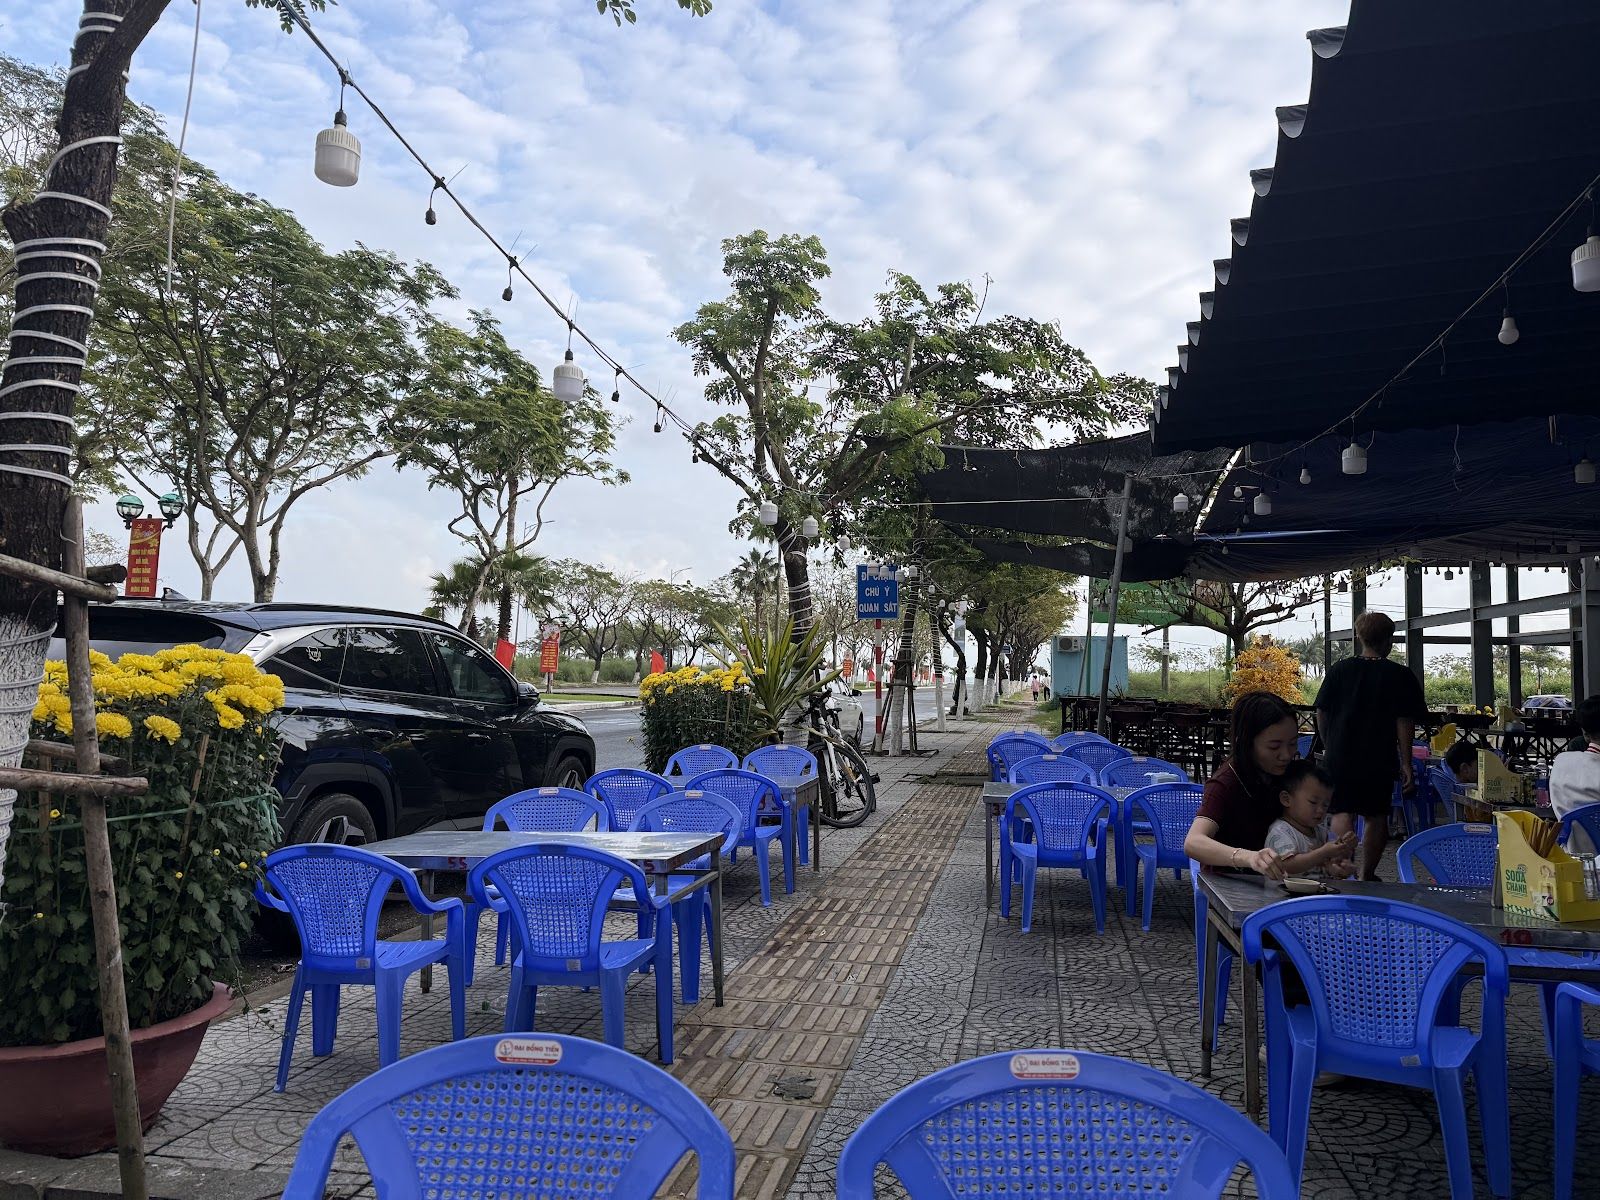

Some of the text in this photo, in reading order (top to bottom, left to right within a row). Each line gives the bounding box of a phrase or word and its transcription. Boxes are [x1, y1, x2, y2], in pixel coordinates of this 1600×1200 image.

[864, 585, 890, 597] CHÚ Ý
[859, 601, 898, 613] QUAN SÁT
[1505, 869, 1527, 884] SODA
